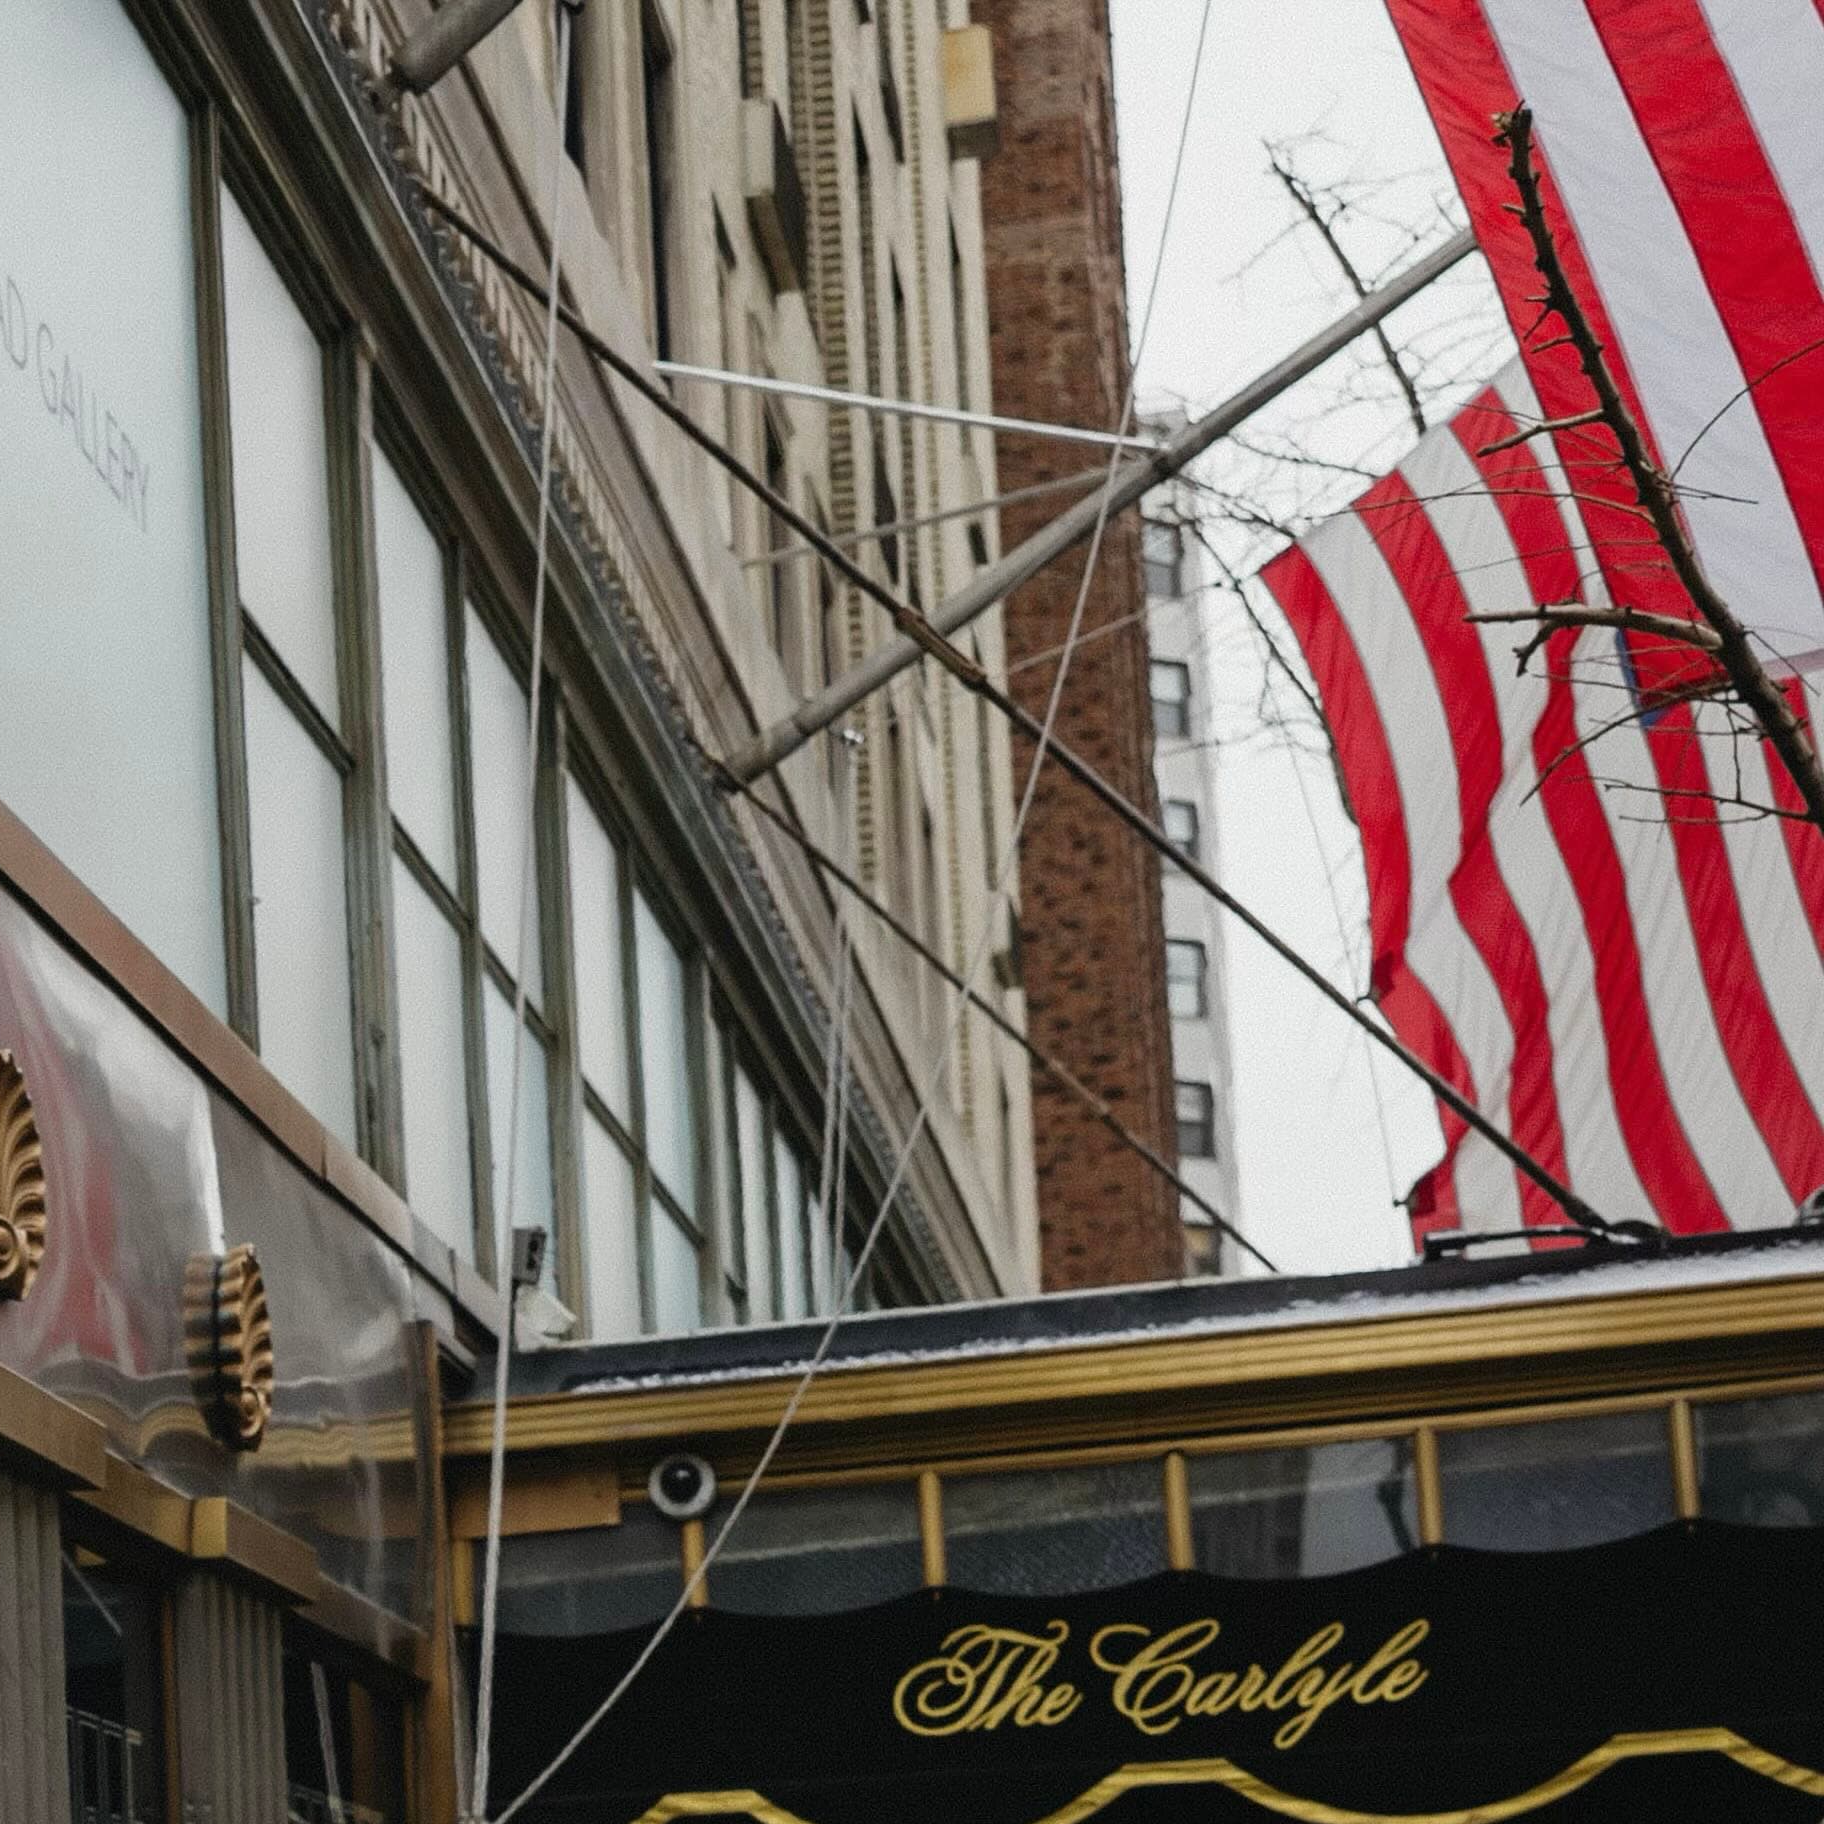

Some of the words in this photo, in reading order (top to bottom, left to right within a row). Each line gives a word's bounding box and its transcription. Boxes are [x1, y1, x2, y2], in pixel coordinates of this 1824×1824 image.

[35, 323, 153, 533] GALLERY
[891, 1618, 1084, 1738] The
[1088, 1618, 1431, 1750] Carlyle
